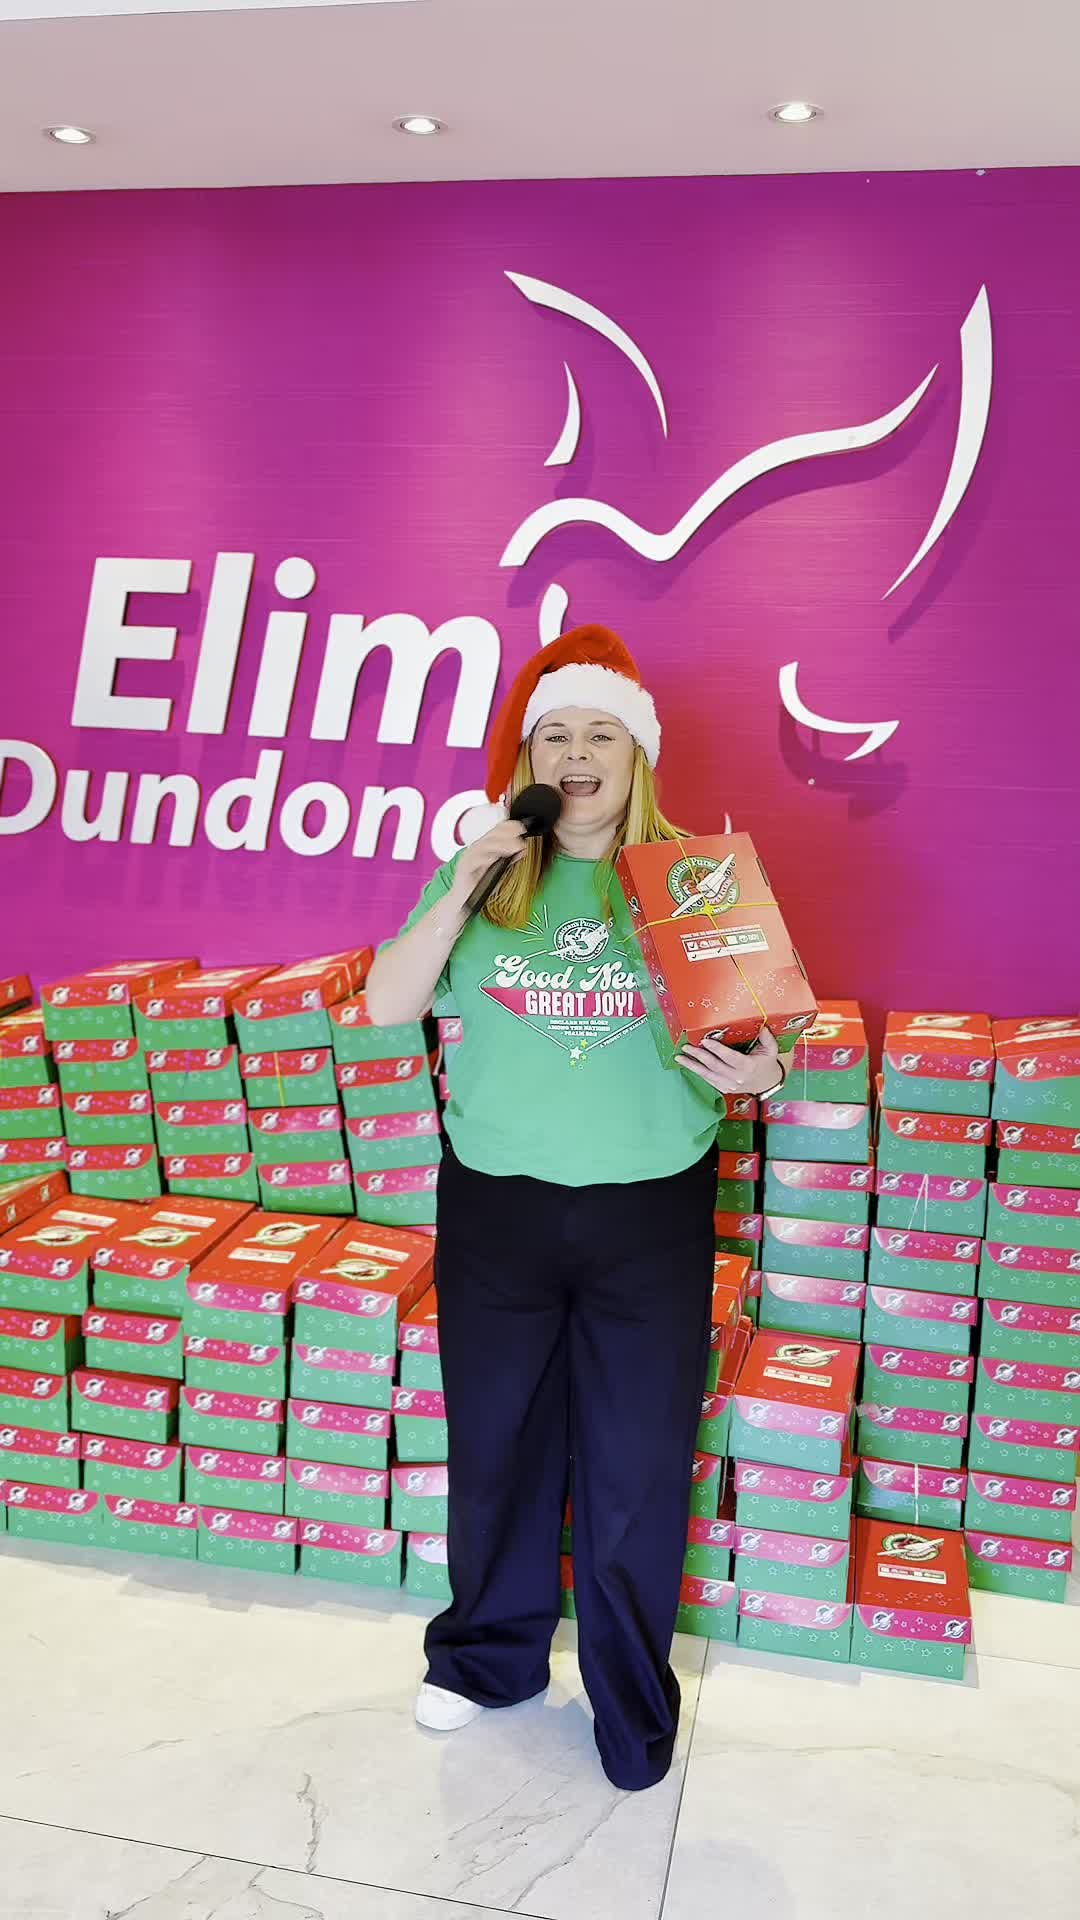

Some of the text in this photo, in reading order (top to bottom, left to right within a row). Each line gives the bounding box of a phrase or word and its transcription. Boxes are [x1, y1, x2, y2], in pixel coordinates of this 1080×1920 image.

[71, 552, 501, 748] Elim
[494, 954, 574, 989] Good
[525, 990, 634, 1017] GREAT JOY!
